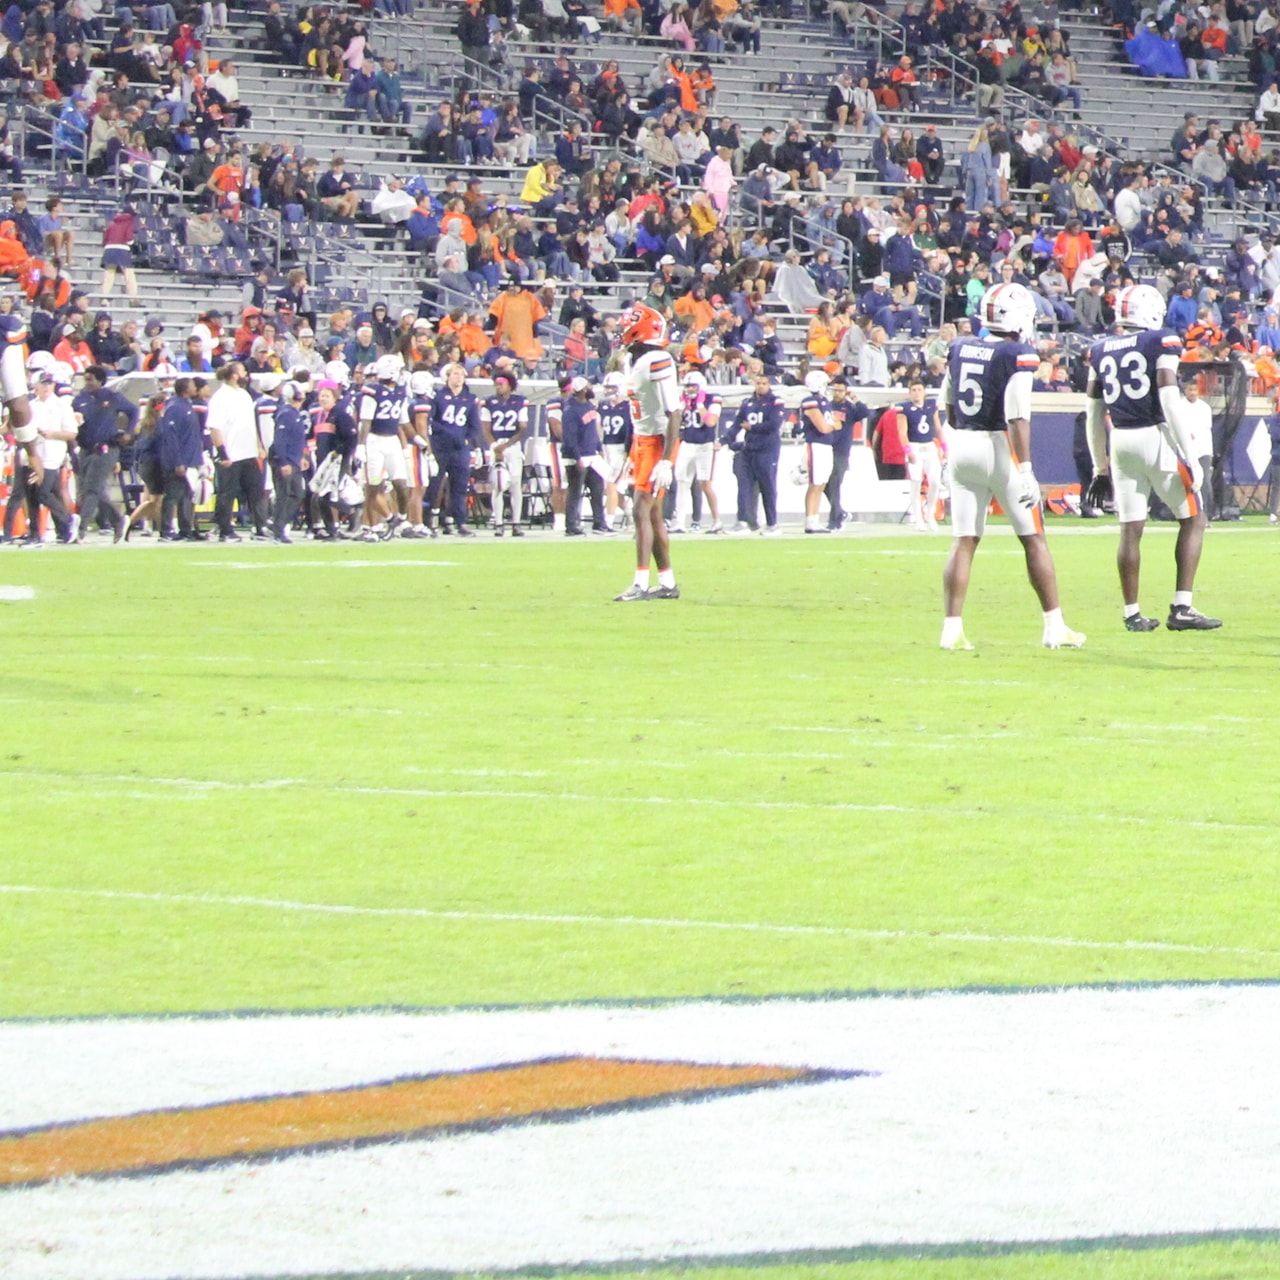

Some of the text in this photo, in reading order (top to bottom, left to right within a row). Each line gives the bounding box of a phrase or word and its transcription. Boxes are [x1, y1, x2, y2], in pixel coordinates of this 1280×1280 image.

[958, 362, 986, 417] 5
[1099, 352, 1152, 406] 33
[376, 399, 402, 420] 26
[441, 406, 468, 427] 46
[491, 410, 518, 432] 22
[602, 415, 624, 435] 49
[917, 416, 930, 434] 6
